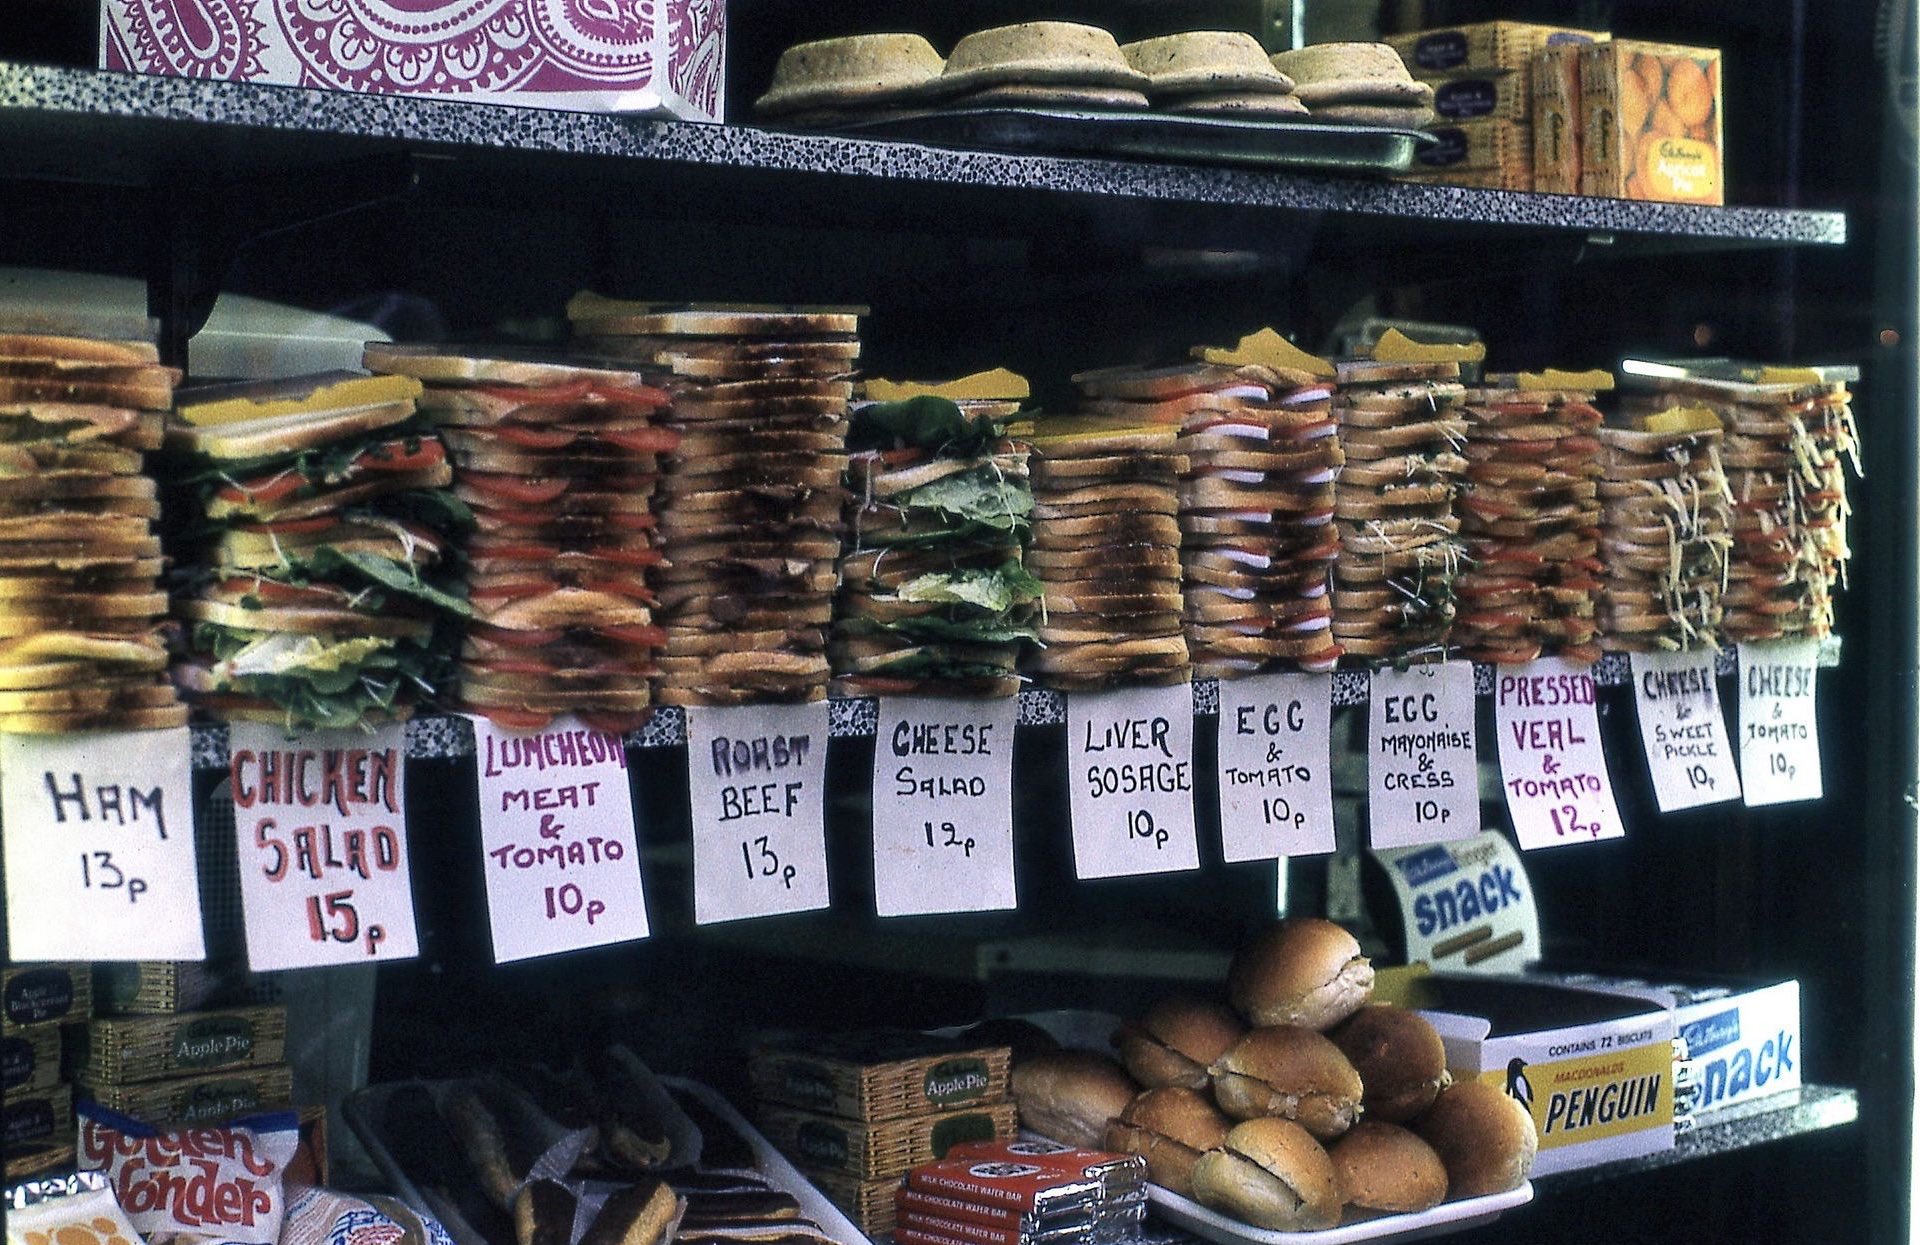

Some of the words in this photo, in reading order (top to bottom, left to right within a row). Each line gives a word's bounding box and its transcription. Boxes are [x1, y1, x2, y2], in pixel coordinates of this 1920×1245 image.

[1500, 675, 1596, 707] PRESSED
[1643, 667, 1713, 700] CHEESE
[1749, 665, 1811, 698] CHEESE
[1237, 700, 1304, 735] EGG
[1385, 693, 1438, 724] EGG
[1676, 702, 1692, 721] &
[1771, 701, 1783, 720] &
[892, 720, 993, 757] CHEESE
[1085, 717, 1173, 757] LIVER
[1512, 717, 1585, 751] VEAL
[1655, 723, 1713, 742] SWEET
[1748, 723, 1808, 742] TOMATO
[485, 728, 629, 778] LUNCHEON
[711, 735, 810, 777] ROAST
[1266, 742, 1282, 763] &
[1418, 752, 1435, 773] &
[1543, 754, 1561, 775] &
[1664, 742, 1718, 760] PICKLE
[1769, 752, 1796, 780] 10p
[230, 748, 400, 817] CHICKEN
[895, 766, 986, 799] SALAD
[1087, 762, 1191, 798] SOSAGE
[1226, 765, 1311, 788] TOMATO
[1384, 771, 1454, 790] CRESS
[1508, 773, 1601, 800] TOMATO
[1686, 765, 1715, 792] 10p
[45, 771, 168, 840] HAM
[502, 782, 601, 812] MEAT
[718, 782, 803, 821] BEEF
[1416, 800, 1451, 824] 10p
[540, 814, 565, 840] &
[1127, 809, 1169, 850] 10p
[1262, 798, 1305, 830] 10p
[1550, 805, 1601, 838] 12p
[255, 817, 400, 883] SALAD
[490, 836, 625, 870] TOMATO
[923, 821, 976, 857] 12p
[81, 852, 148, 903] 13p
[742, 836, 796, 889] 13p
[544, 883, 606, 925] 10p
[1413, 863, 1522, 937] snack
[305, 888, 387, 955] 15p
[177, 1038, 223, 1058] Apple
[224, 1036, 250, 1052] Pie
[1549, 1040, 1597, 1057] CONTAINS
[1601, 1036, 1612, 1048] 72
[1618, 1030, 1653, 1046] BISCUITS
[928, 1078, 965, 1096] Apple
[966, 1074, 987, 1089] Pie
[1544, 1073, 1661, 1134] PENGUIN
[922, 1175, 937, 1184] MILK
[939, 1178, 979, 1193] CHOCOLATE
[980, 1187, 1004, 1199] WAFER
[1006, 1192, 1022, 1202] BAR
[924, 1195, 963, 1210] CHOCOLATE
[966, 1204, 989, 1215] WAFER
[991, 1208, 1007, 1219] BAR
[925, 1216, 963, 1232] CHOCOLATE
[965, 1227, 988, 1238] WAFER
[990, 1233, 1005, 1243] BAR
